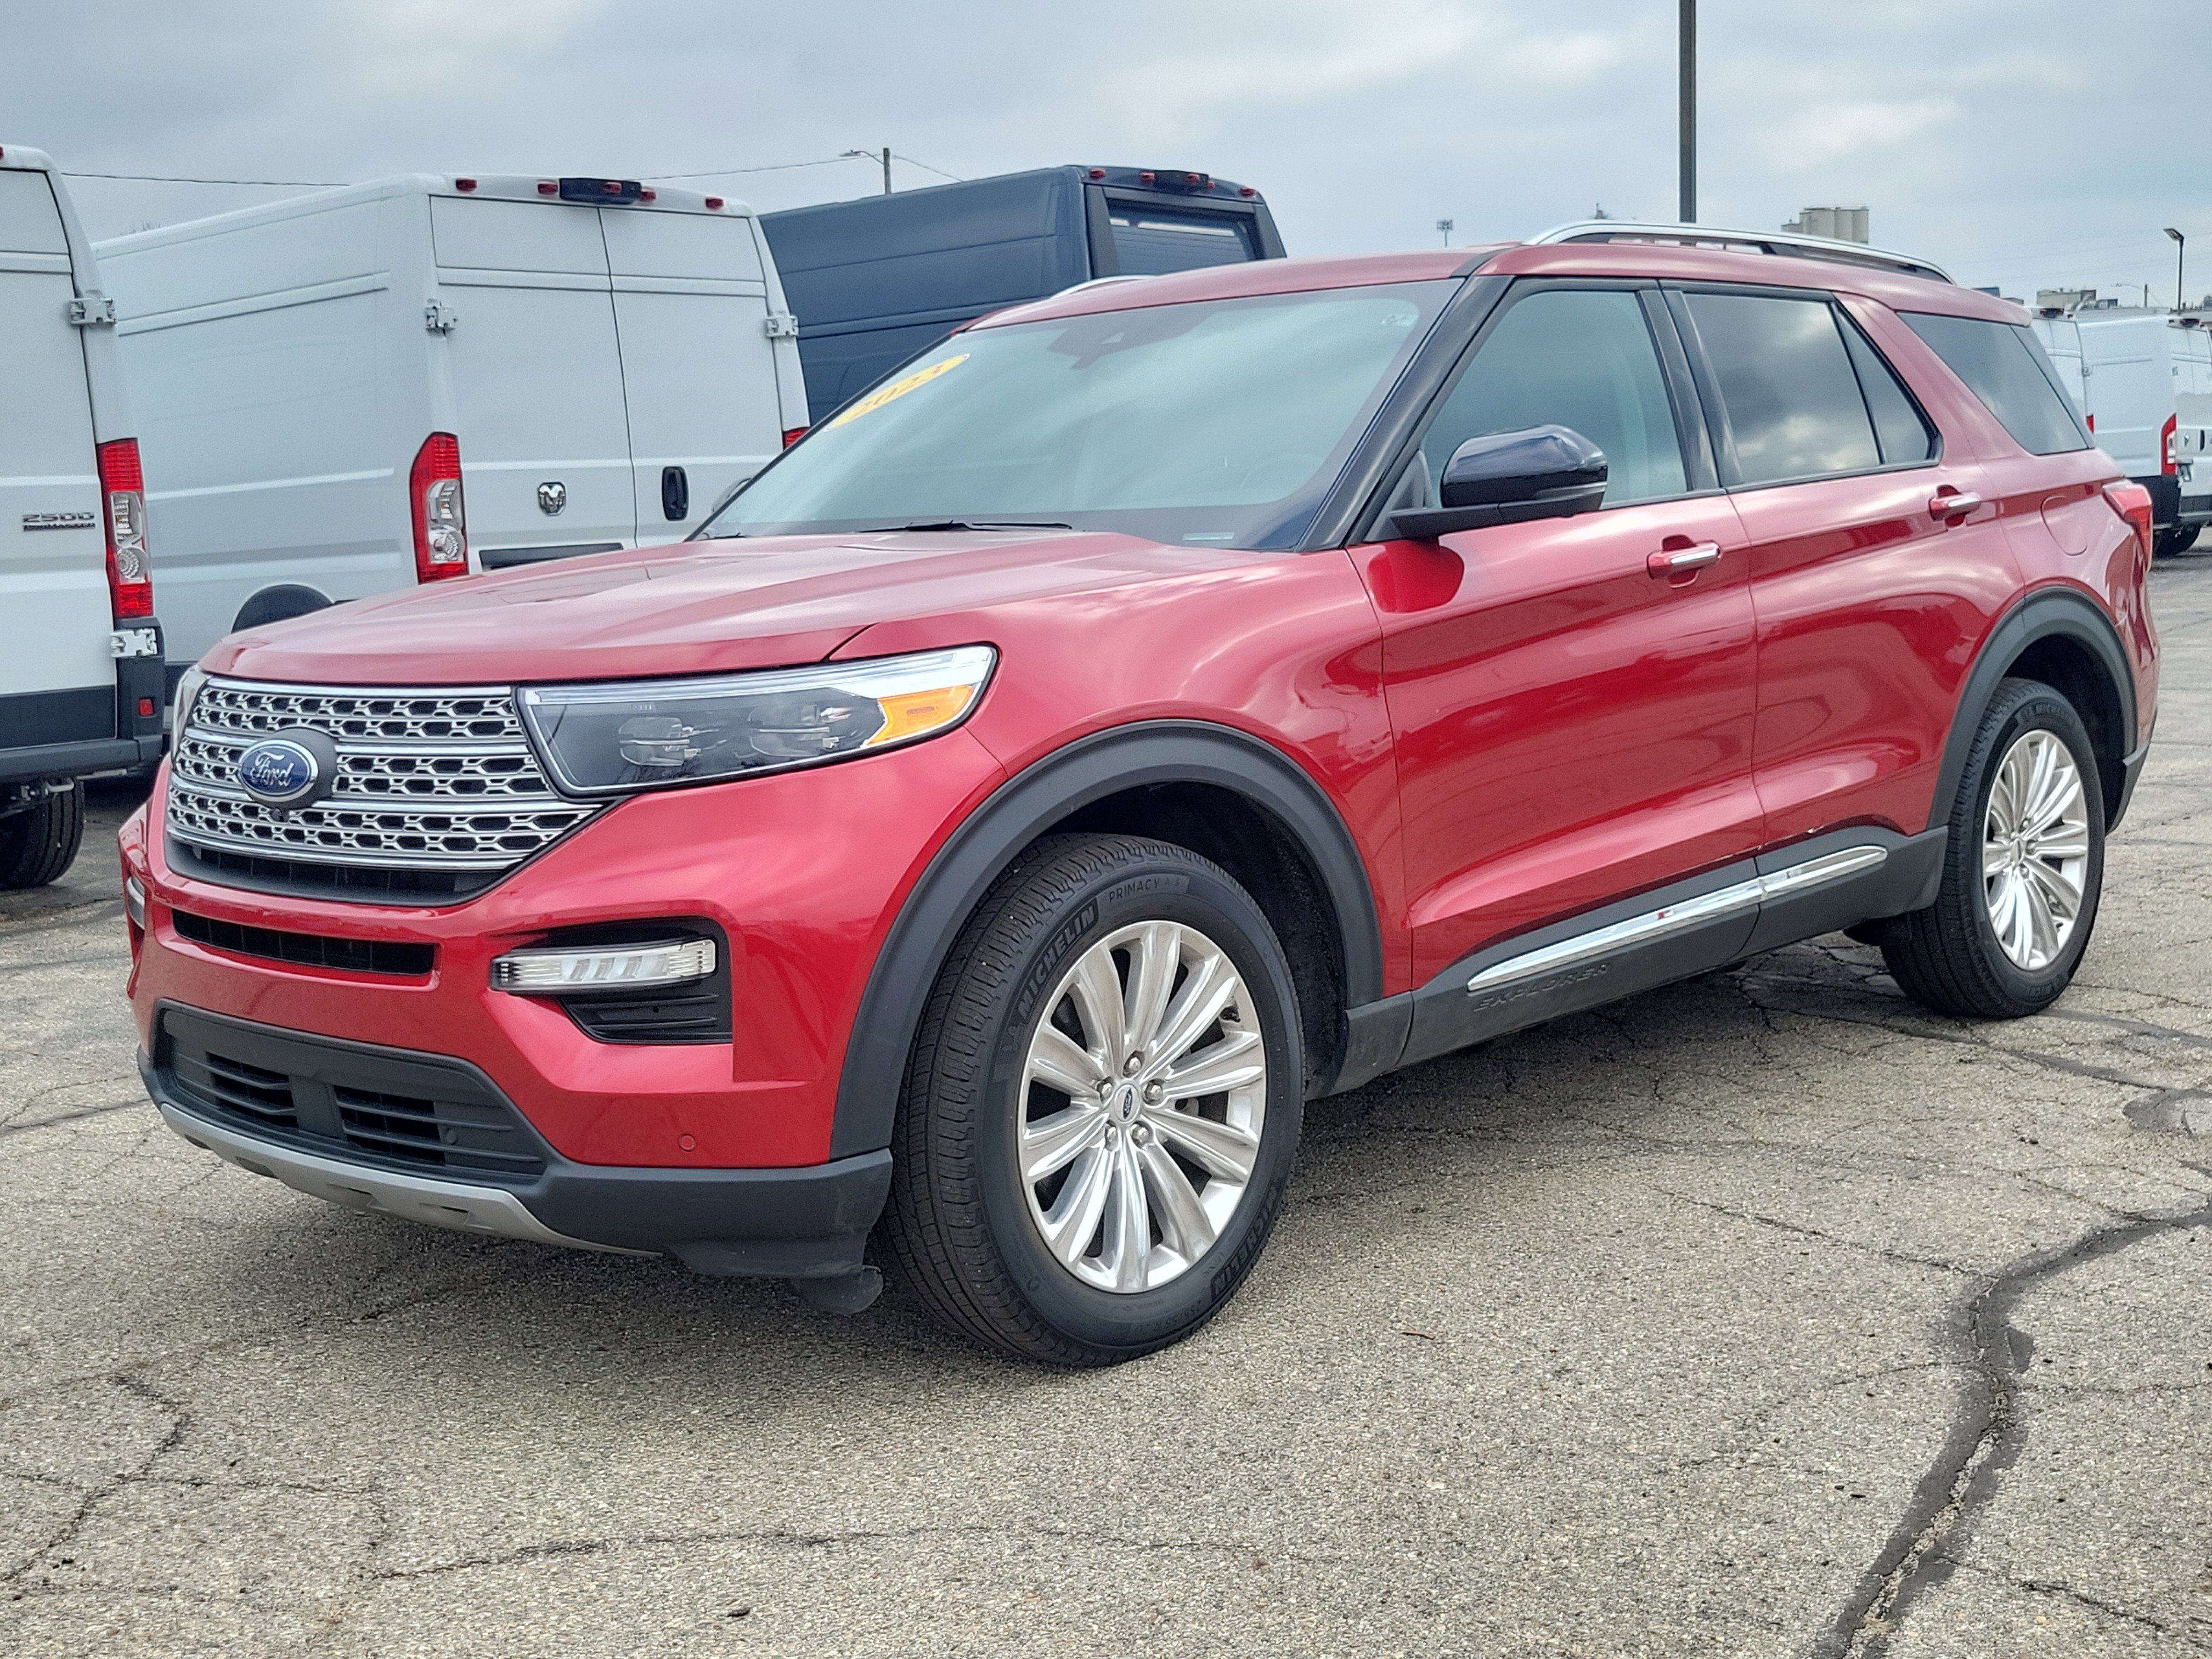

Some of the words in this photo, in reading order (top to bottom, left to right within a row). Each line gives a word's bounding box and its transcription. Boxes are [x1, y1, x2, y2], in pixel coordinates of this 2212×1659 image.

[22, 512, 95, 522] 2500
[250, 752, 294, 787] Ford
[1109, 878, 1160, 904] PRIMACY
[1017, 904, 1096, 1020] MICHELIN
[1213, 1183, 1278, 1296] MICHELIN
